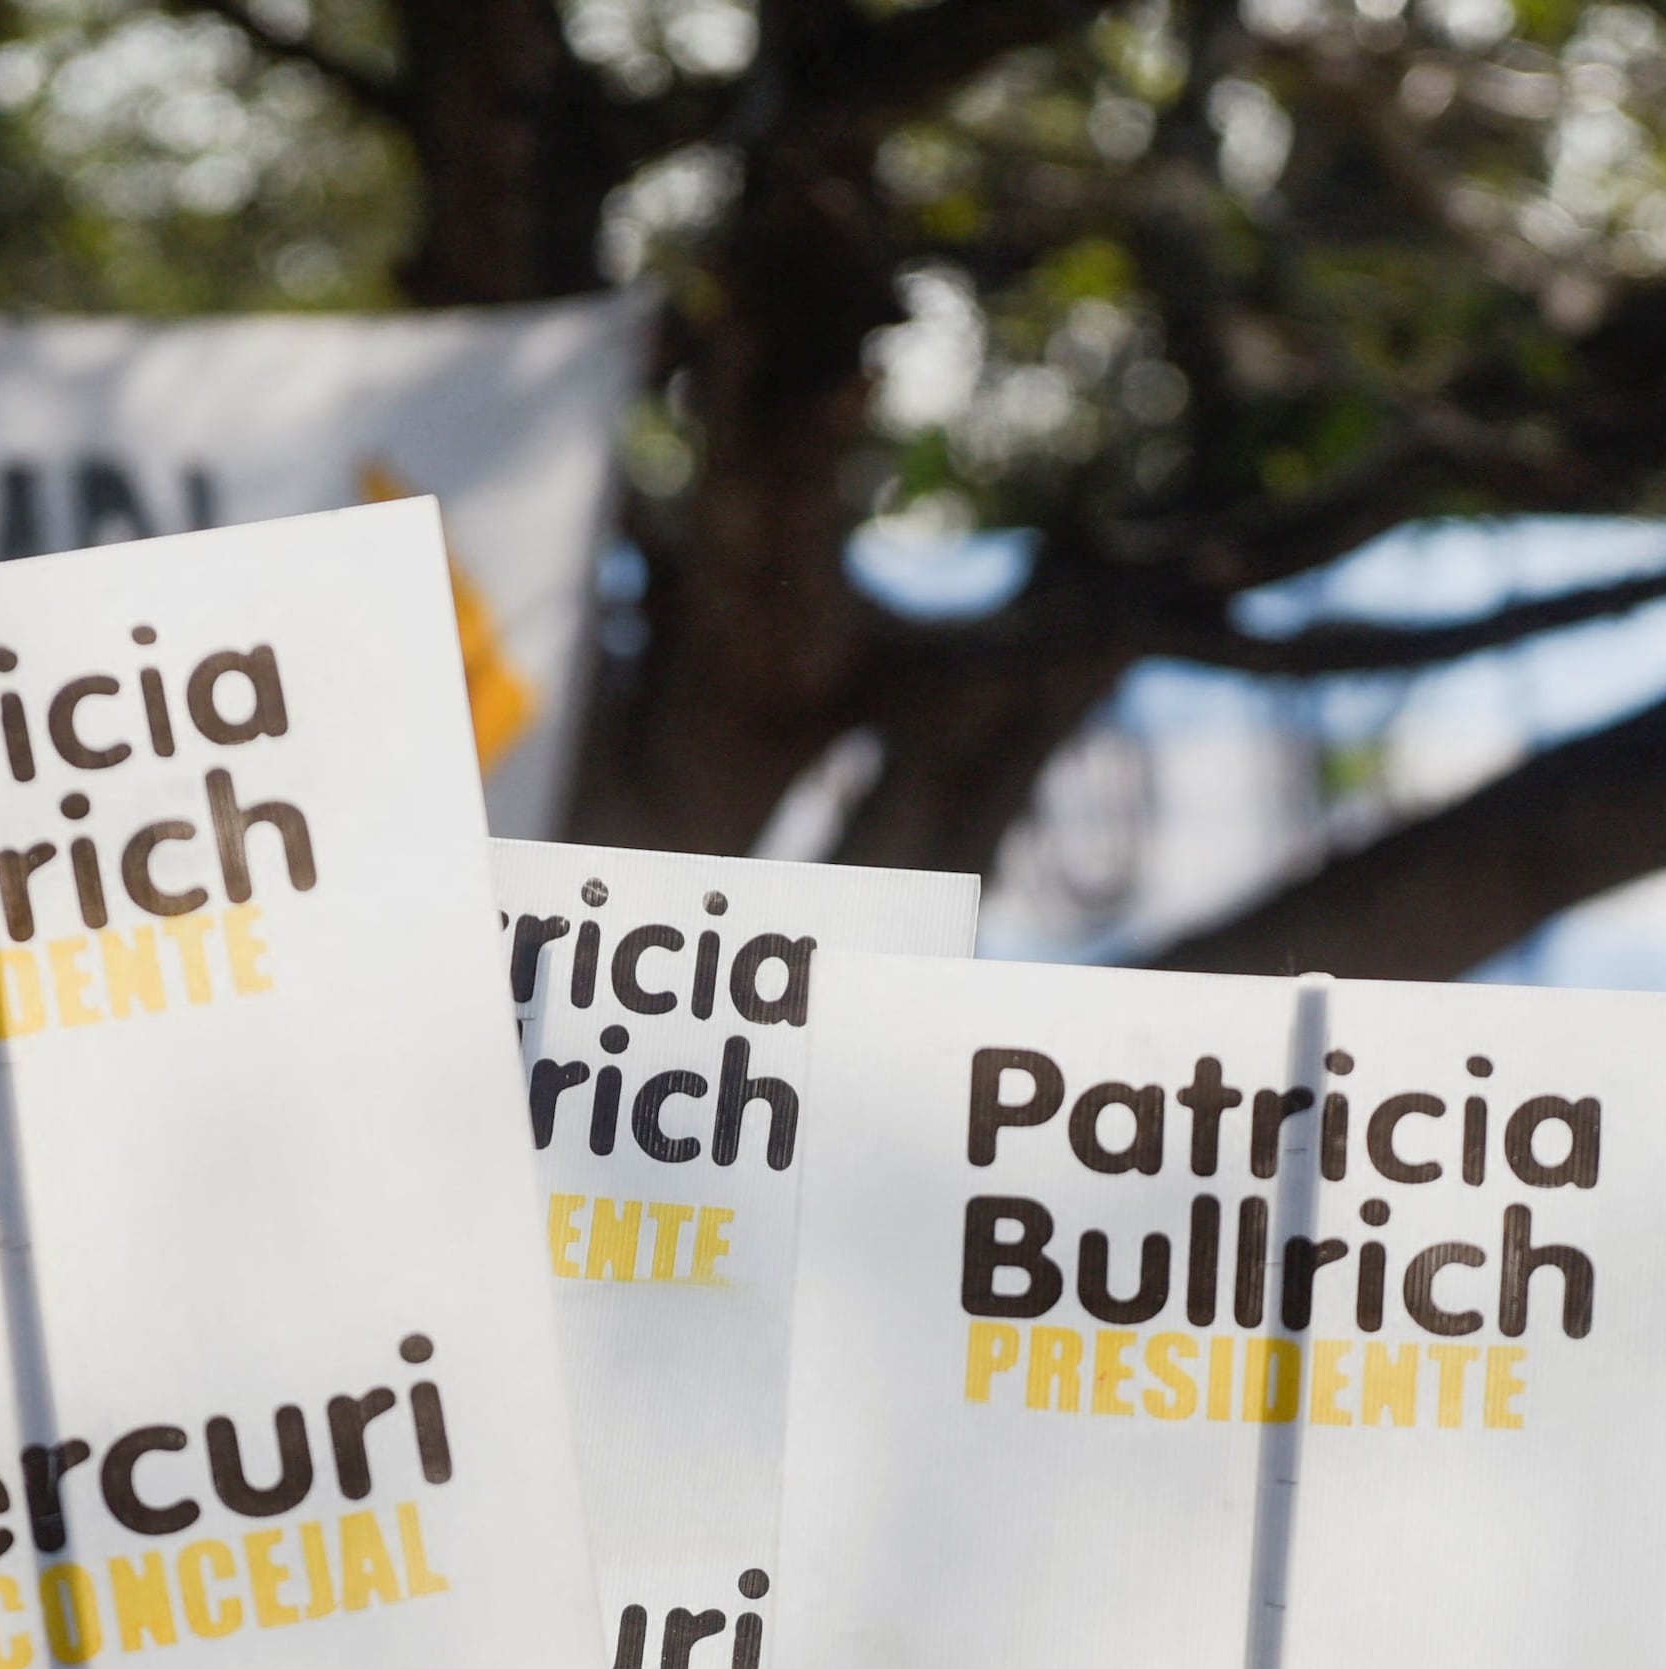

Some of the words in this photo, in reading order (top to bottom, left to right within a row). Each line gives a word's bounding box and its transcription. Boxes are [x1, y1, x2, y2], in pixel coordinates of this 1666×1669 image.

[510, 877, 817, 1027] ricia
[529, 1025, 799, 1171] rich
[967, 1047, 1602, 1188] Patricia
[961, 1193, 1595, 1339] Bullrich
[963, 1320, 1527, 1430] PRESIDENTE
